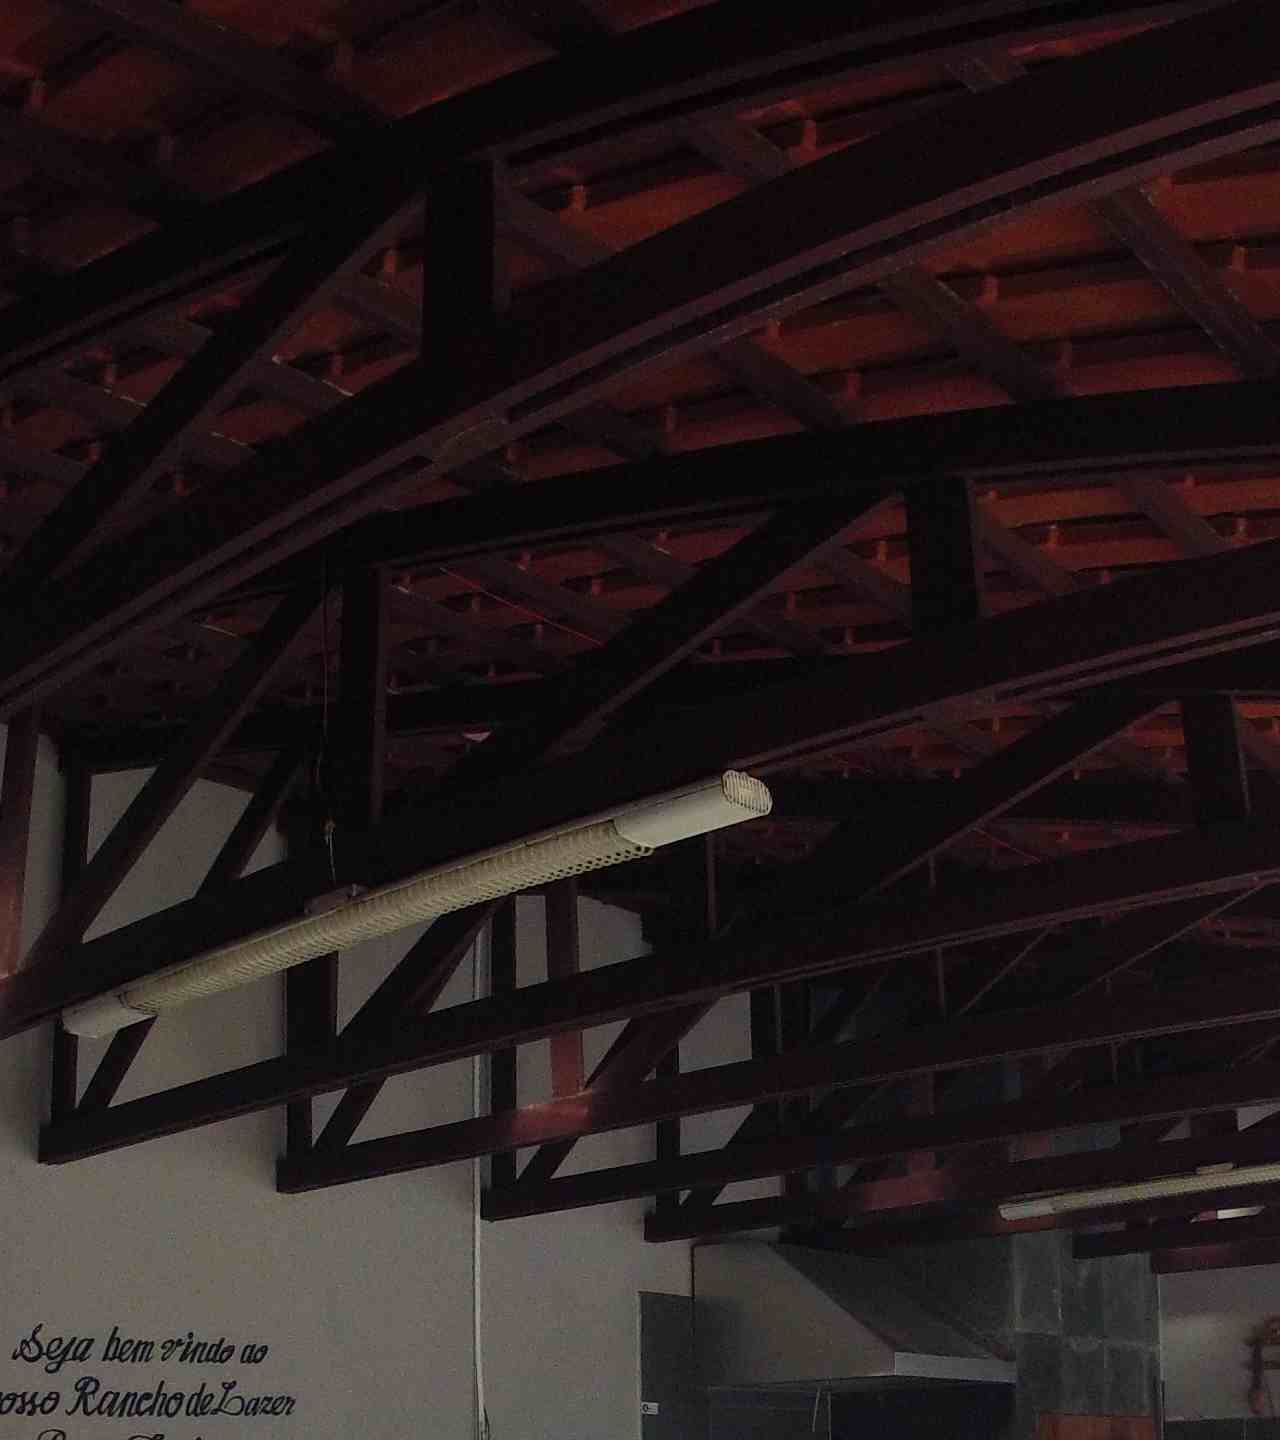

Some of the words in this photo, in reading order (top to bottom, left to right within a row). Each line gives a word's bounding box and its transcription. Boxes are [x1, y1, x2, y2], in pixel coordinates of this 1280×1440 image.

[12, 1323, 94, 1373] Seja
[101, 1326, 152, 1362] bem
[160, 1332, 234, 1363] vindo
[240, 1342, 268, 1363] ao
[65, 1376, 183, 1417] Rancho
[185, 1382, 214, 1417] de
[210, 1380, 296, 1416] Lazer
